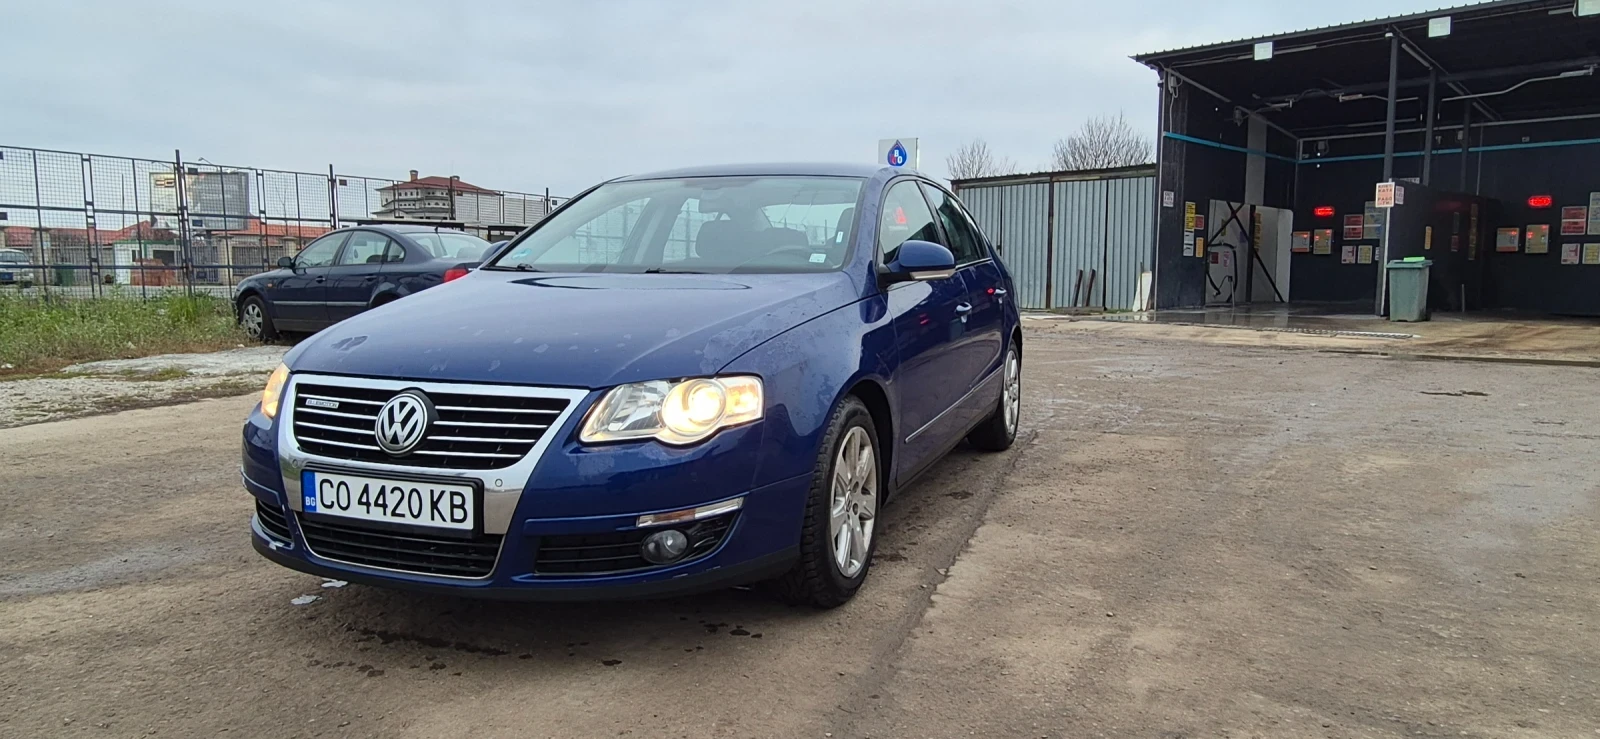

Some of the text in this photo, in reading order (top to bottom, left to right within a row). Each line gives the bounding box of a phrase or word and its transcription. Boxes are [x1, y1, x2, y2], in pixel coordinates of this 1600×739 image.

[380, 397, 422, 448] VW
[305, 496, 315, 507] BG
[319, 478, 468, 524] CO 4420 KB
